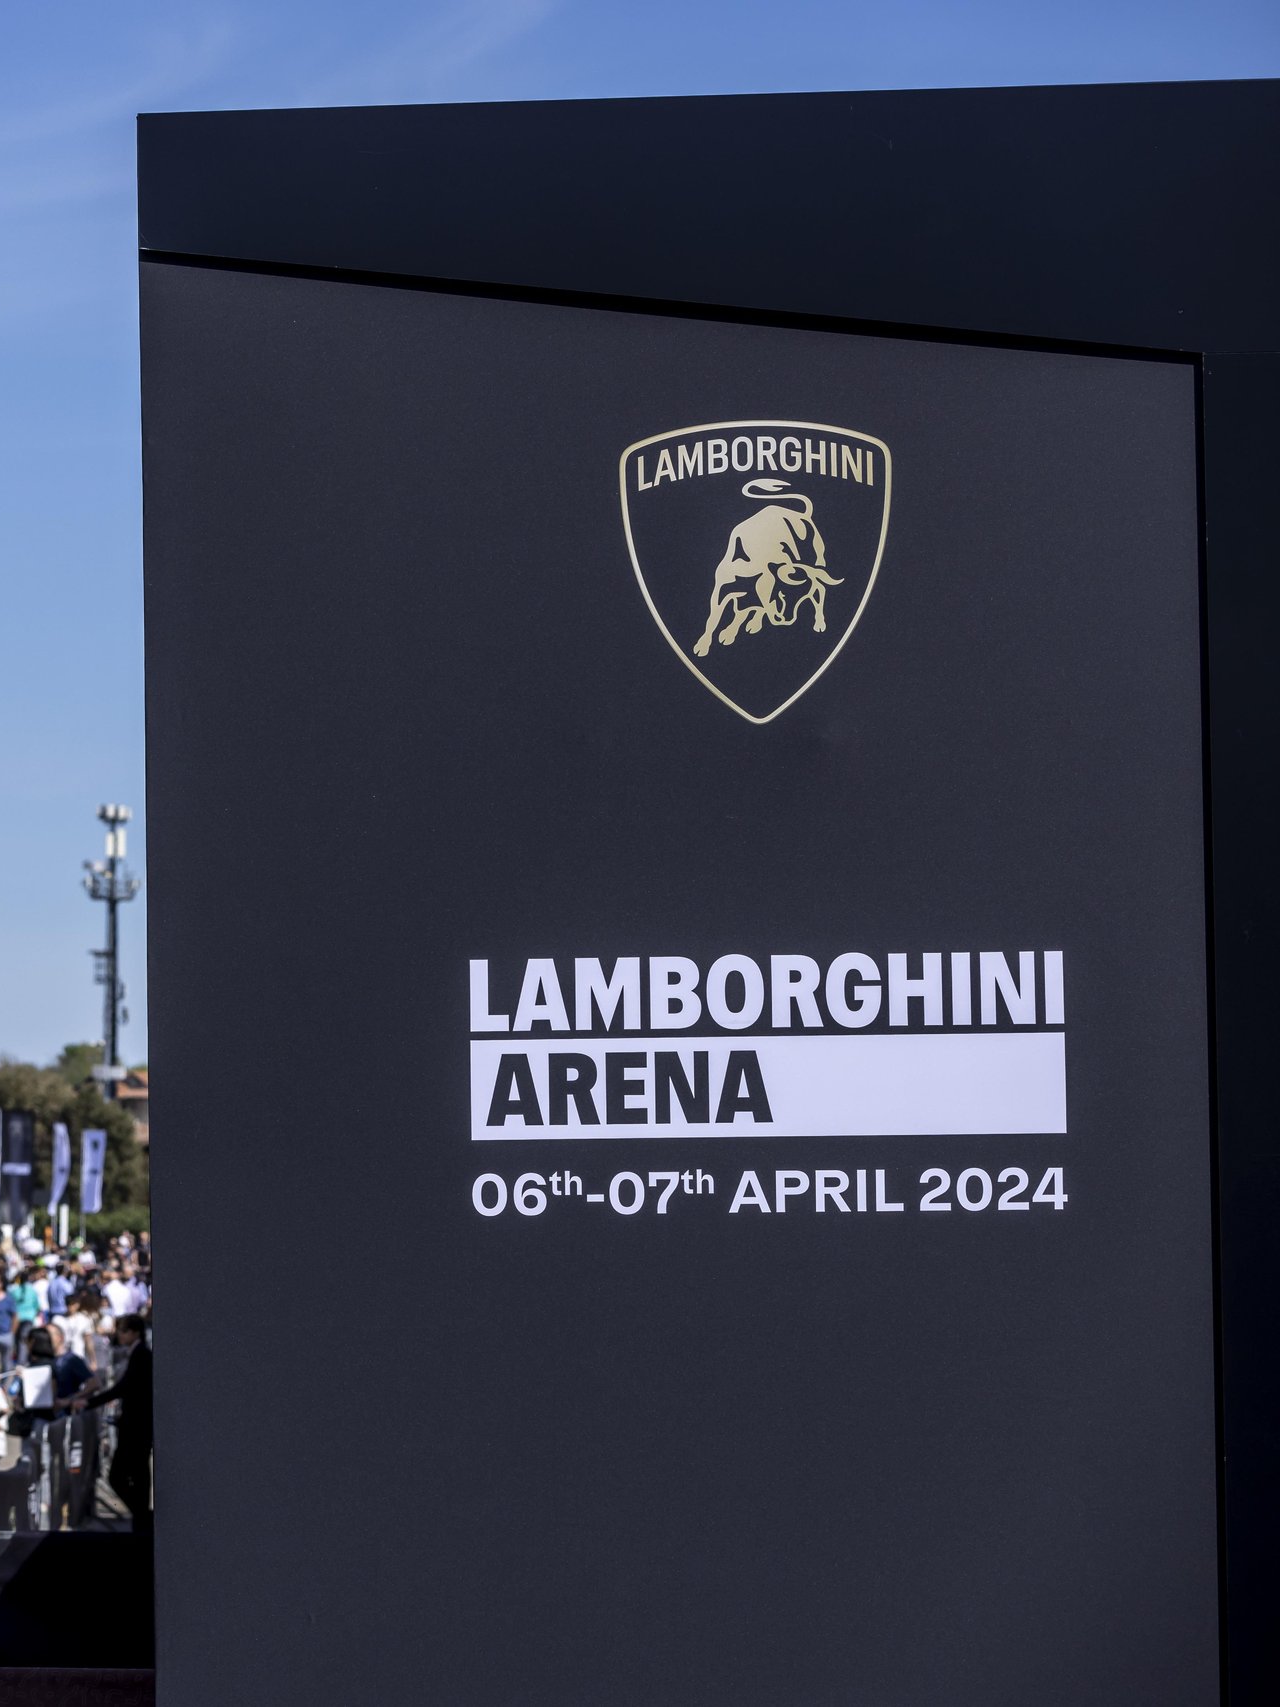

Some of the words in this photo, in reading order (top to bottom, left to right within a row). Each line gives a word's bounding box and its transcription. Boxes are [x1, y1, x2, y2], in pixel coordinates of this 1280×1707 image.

[637, 436, 874, 492] LAMBORGHINI
[469, 950, 1066, 1032] LAMBORGHINI
[486, 1050, 774, 1126] ARENA
[471, 1168, 715, 1217] 06th-07th
[728, 1169, 905, 1214] APRIL
[919, 1167, 1069, 1212] 2024
